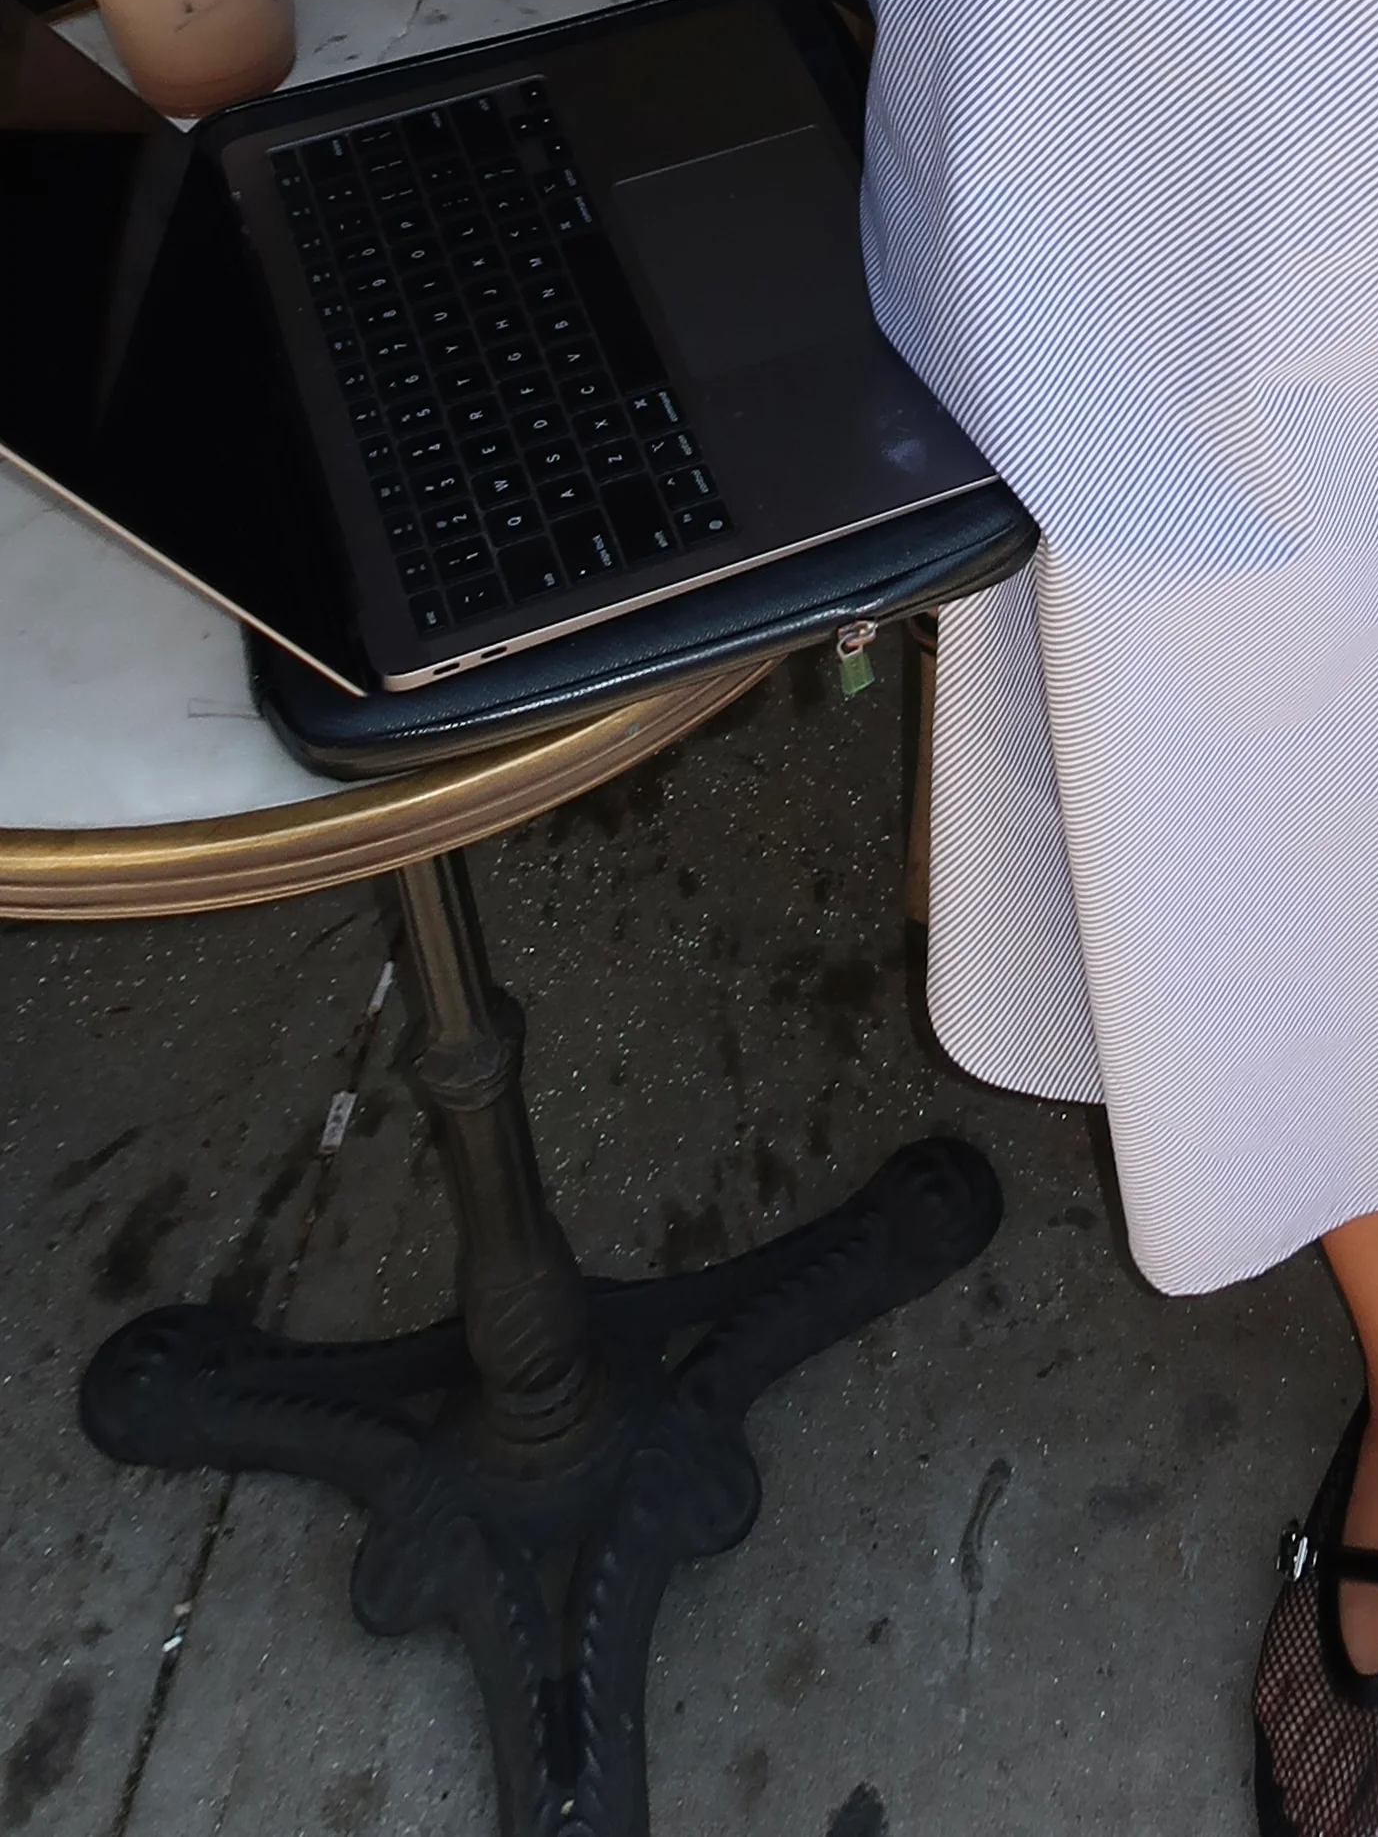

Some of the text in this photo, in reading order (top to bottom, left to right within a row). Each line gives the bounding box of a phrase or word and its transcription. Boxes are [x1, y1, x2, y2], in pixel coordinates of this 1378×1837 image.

[361, 247, 376, 256] 0
[410, 249, 425, 259] O
[372, 278, 386, 287] 9
[542, 288, 555, 298] N
[382, 309, 397, 318] 8
[434, 311, 448, 321] U
[495, 319, 509, 329] H
[446, 345, 458, 353] Y
[507, 352, 522, 361] G
[567, 353, 580, 362] V
[404, 375, 419, 383] 6
[520, 387, 534, 395] F
[580, 385, 595, 395] C
[416, 408, 431, 417] 5
[469, 410, 483, 420] R
[533, 419, 548, 429] D
[595, 419, 608, 429] X
[481, 445, 496, 454] E
[546, 453, 560, 463] S
[608, 454, 623, 463] Z
[440, 477, 455, 487] 3
[494, 479, 509, 492] W
[560, 488, 574, 498] A
[452, 513, 467, 523] 2
[506, 515, 522, 526] Q
